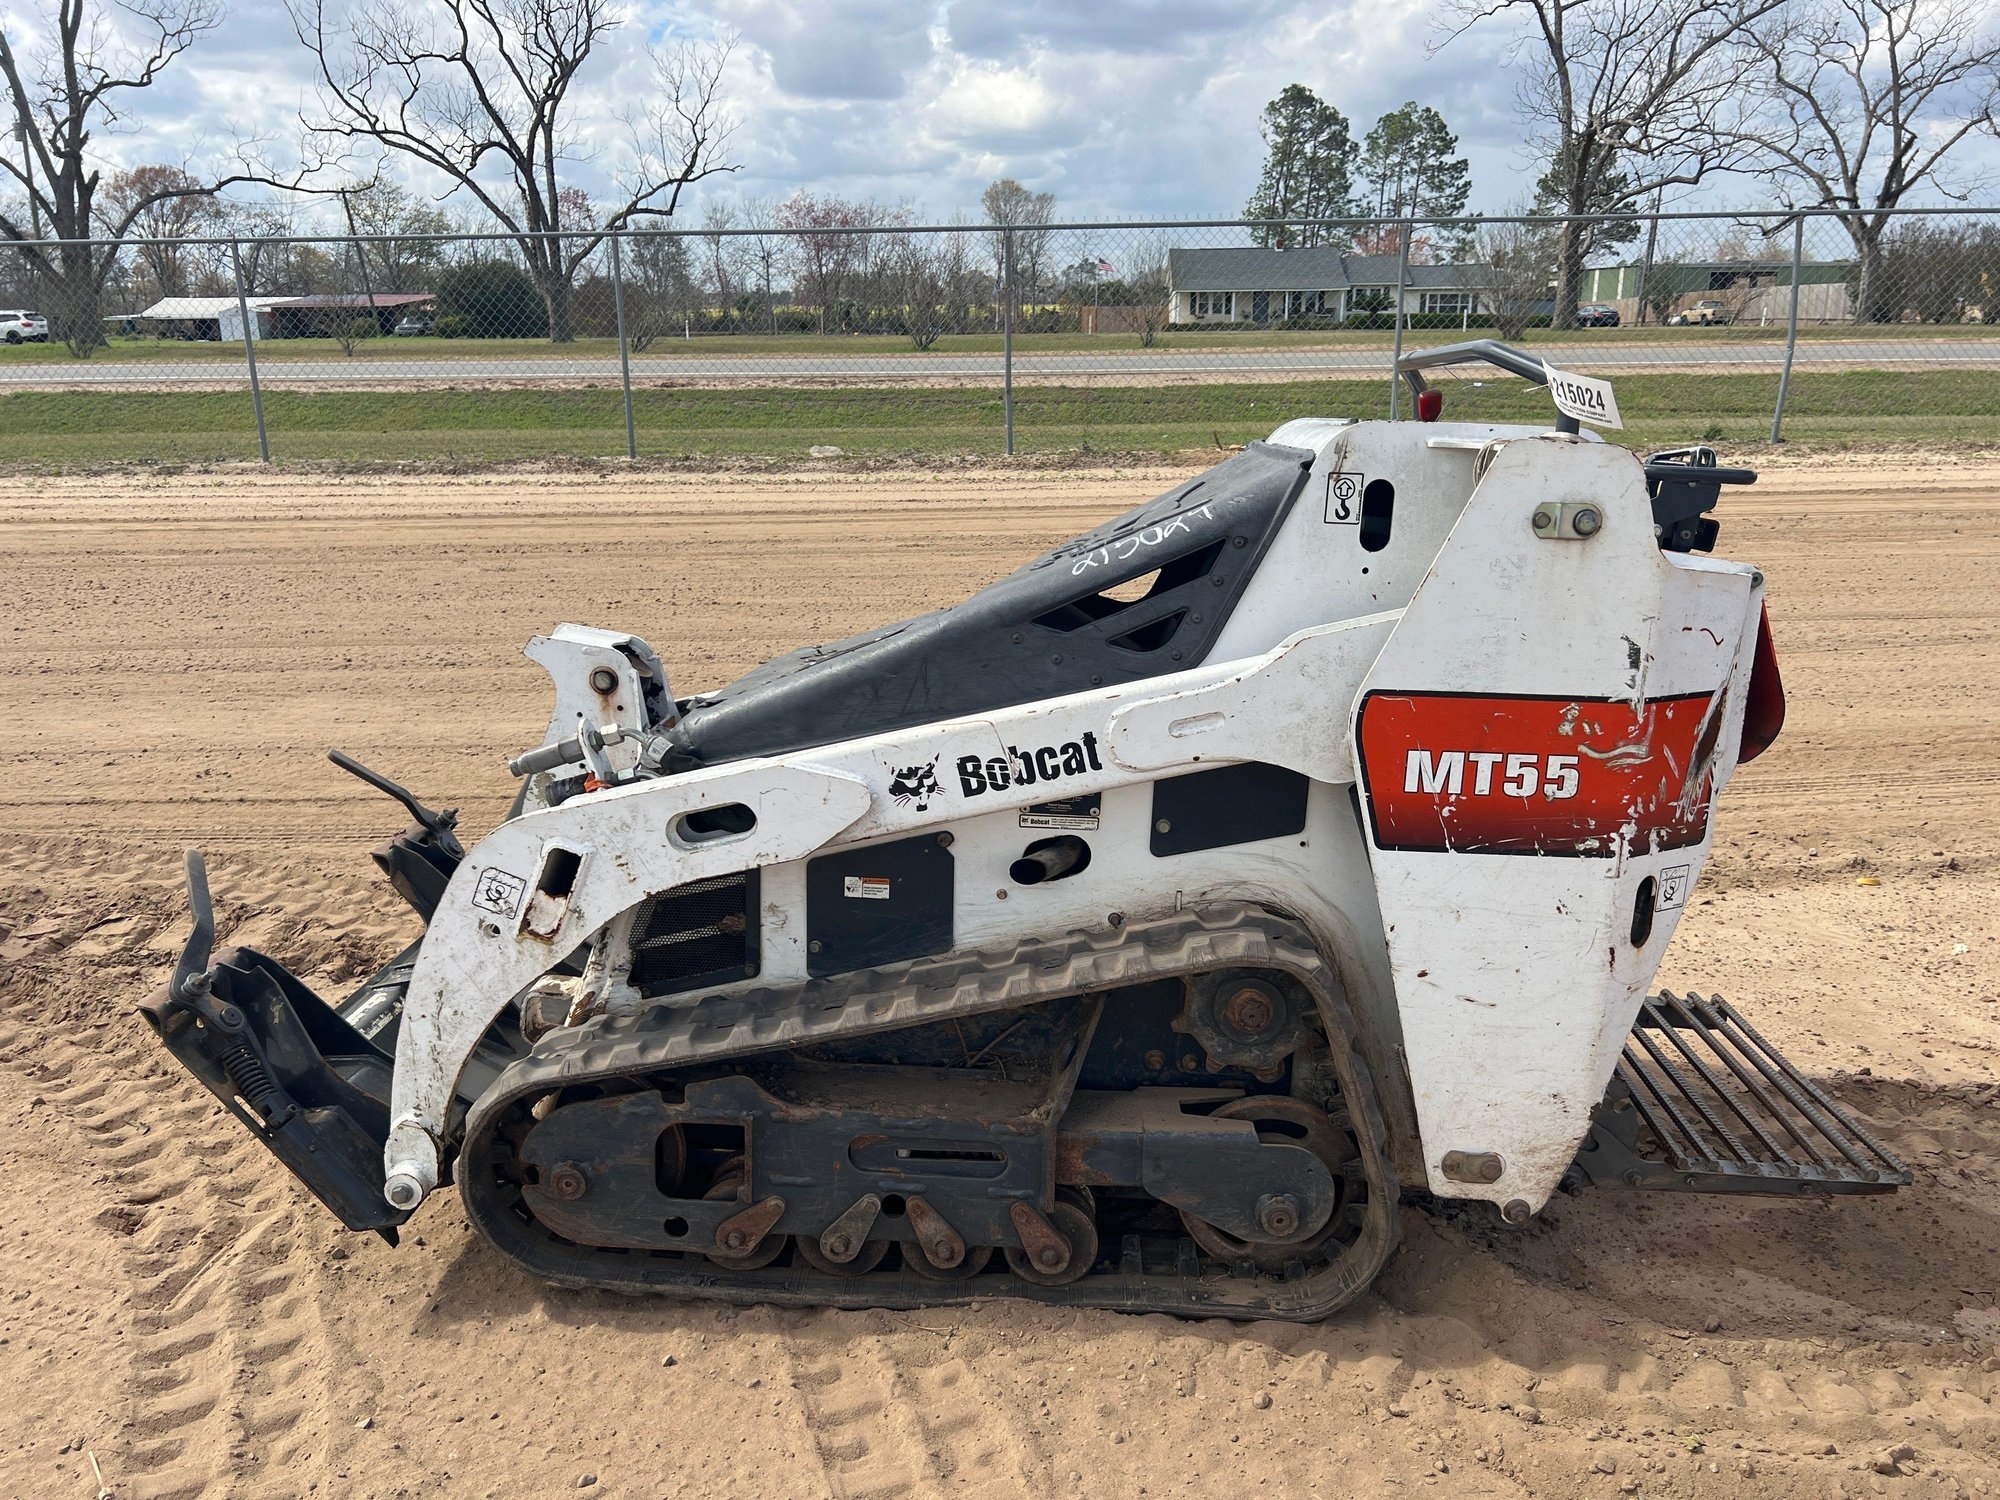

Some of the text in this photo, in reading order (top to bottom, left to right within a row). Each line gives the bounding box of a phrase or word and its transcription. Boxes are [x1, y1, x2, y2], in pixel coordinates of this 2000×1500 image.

[1553, 377, 1605, 411] 215024
[957, 731, 1103, 798] Bobcat
[1403, 750, 1580, 799] MT55
[1030, 818, 1050, 826] Bobcat
